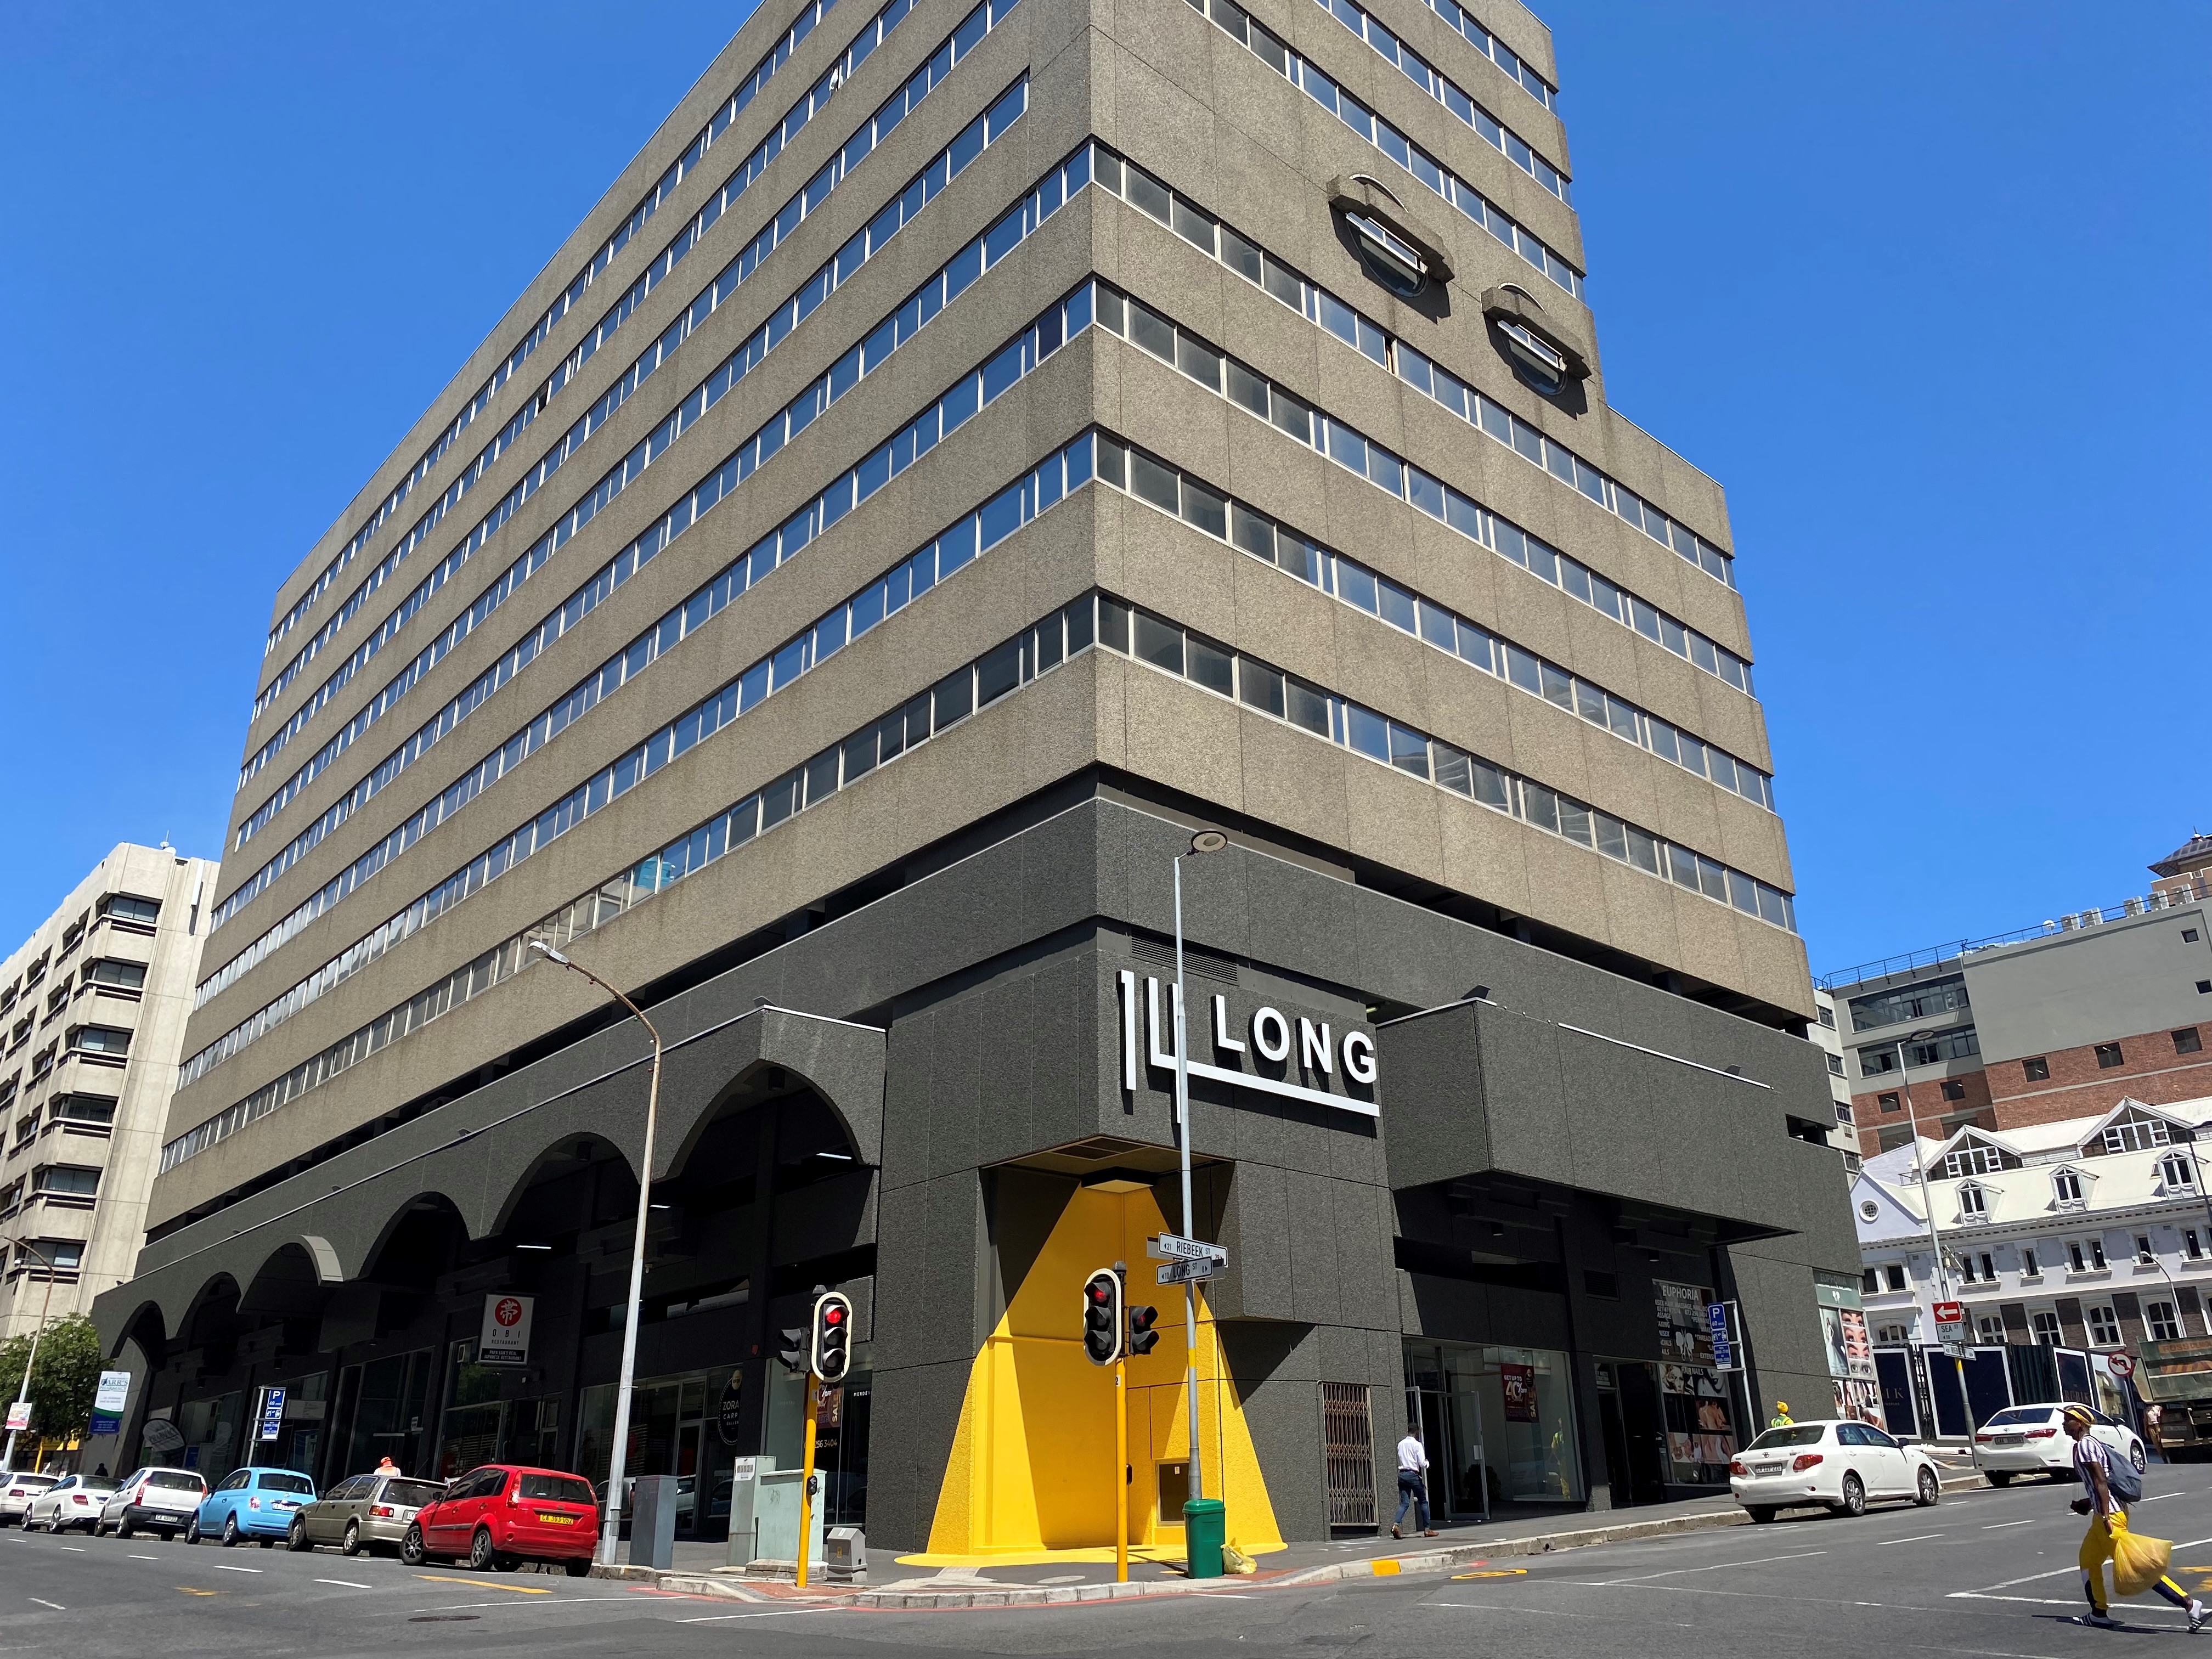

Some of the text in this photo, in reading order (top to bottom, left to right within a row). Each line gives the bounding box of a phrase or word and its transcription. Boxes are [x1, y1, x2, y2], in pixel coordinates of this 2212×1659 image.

[1211, 995, 1377, 1084] LONG
[1176, 1241, 1204, 1257] RIEBEEK
[1173, 1264, 1190, 1278] LONG
[1192, 1262, 1198, 1271] ST
[1820, 1273, 1847, 1285] EUPHORIA
[1662, 1285, 1699, 1301] EUPHORIA
[1713, 1308, 1720, 1318] P
[492, 1329, 521, 1338] OBI
[2163, 1343, 2189, 1352] ROSS
[1691, 1367, 1704, 1375] NAILS
[273, 1391, 281, 1400] P
[723, 1400, 740, 1410] ZORA
[823, 1438, 837, 1448] 3404
